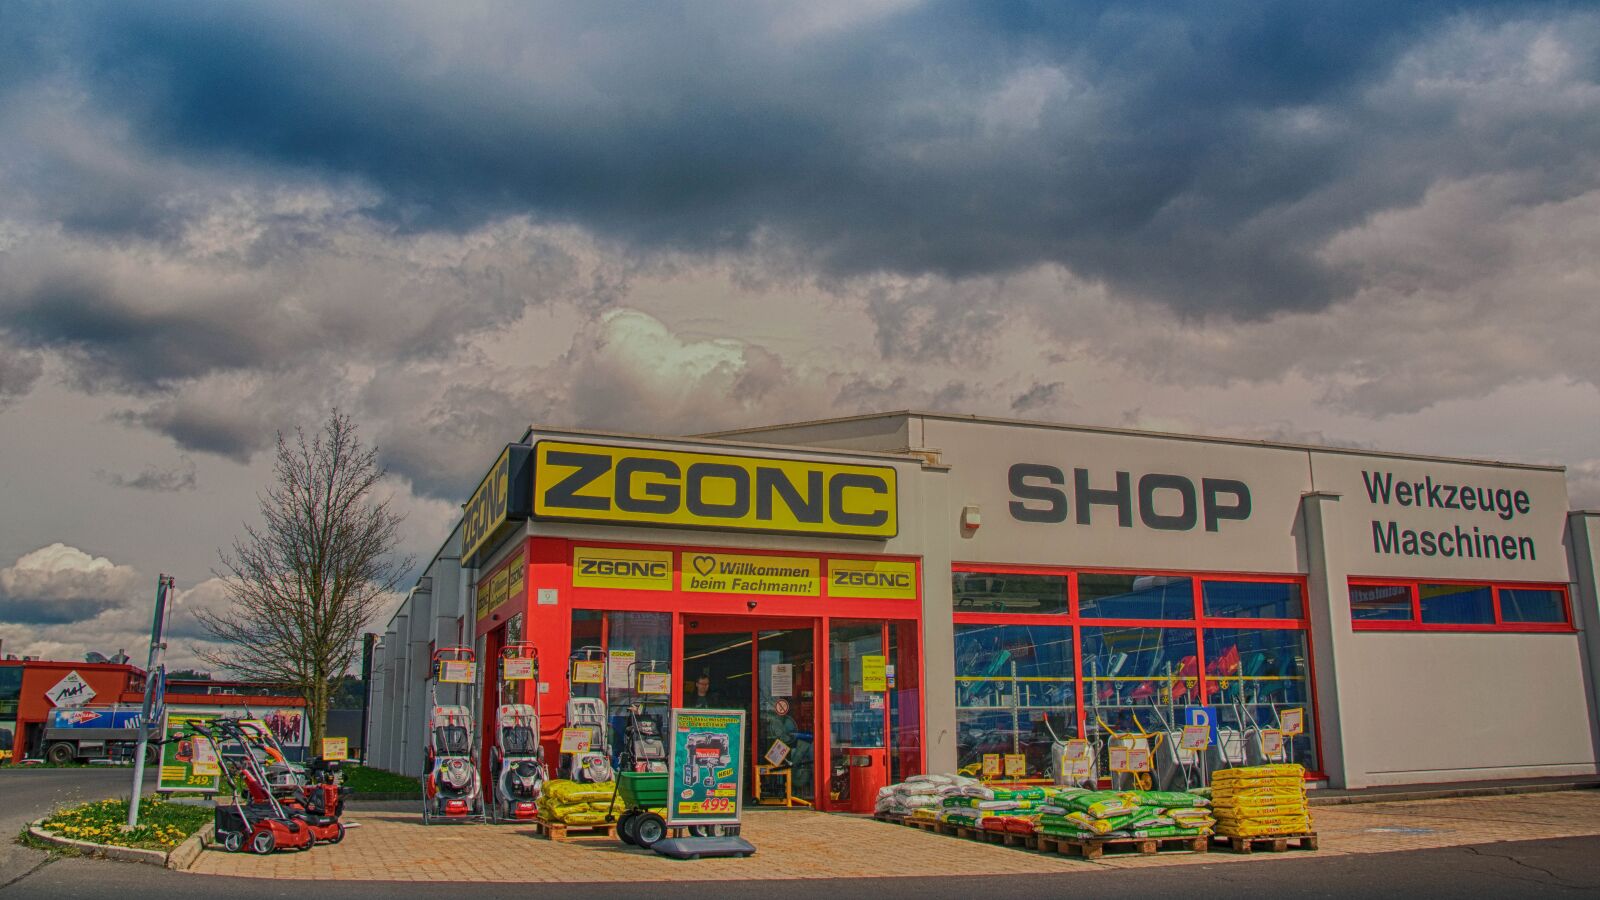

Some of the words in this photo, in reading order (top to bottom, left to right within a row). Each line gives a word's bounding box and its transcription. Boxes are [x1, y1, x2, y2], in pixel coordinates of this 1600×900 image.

[461, 457, 507, 556] ZGONC
[544, 451, 889, 525] ZGONC
[1009, 464, 1250, 531] SHOP
[1361, 470, 1530, 521] Werkzeuge
[1371, 520, 1536, 561] Maschinen
[580, 559, 666, 578] ZGONC
[690, 577, 726, 590] beim
[731, 578, 813, 593] Fachmann!
[720, 560, 810, 577] Willkommen
[834, 571, 910, 588] ZGONC
